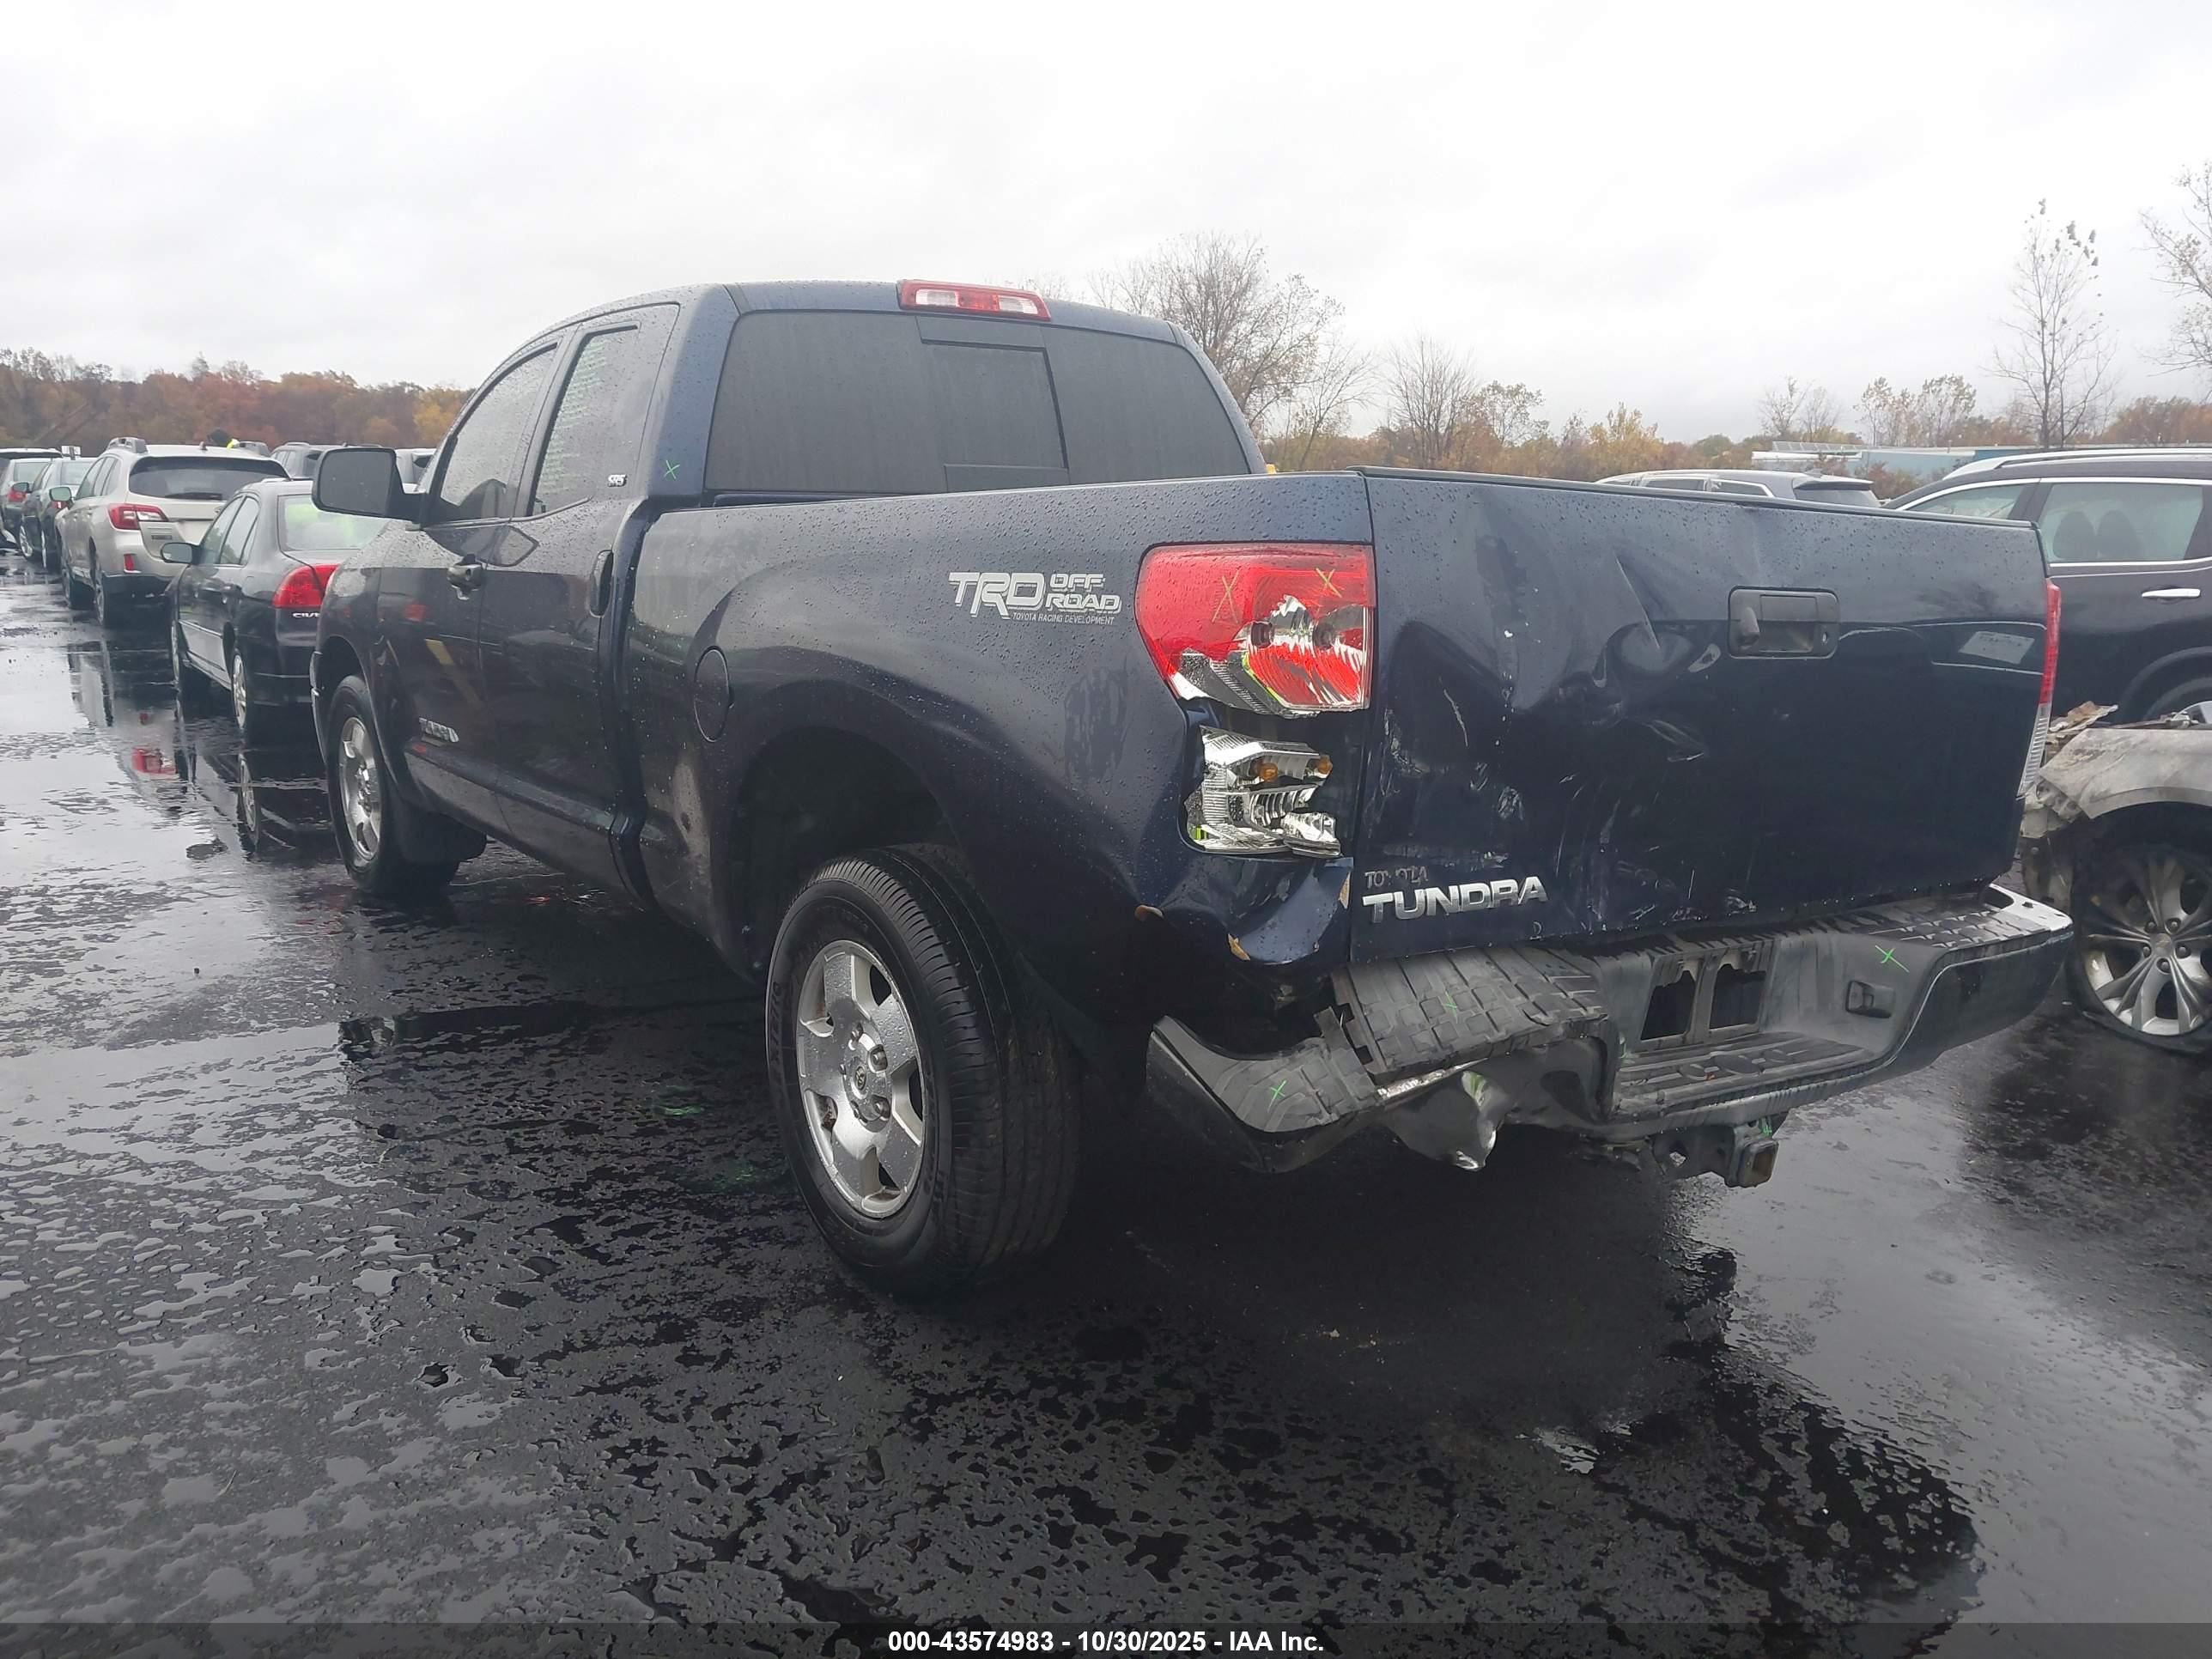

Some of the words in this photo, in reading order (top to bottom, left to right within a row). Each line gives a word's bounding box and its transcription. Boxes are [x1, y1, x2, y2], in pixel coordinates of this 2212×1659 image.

[1049, 573, 1105, 592] OFF
[948, 572, 1046, 619] TRD
[1045, 592, 1121, 614] ROAD
[1012, 611, 1036, 622] TOYOTA
[1037, 613, 1064, 623] RACING
[1064, 615, 1115, 625] DEVELOPMENT
[1362, 876, 1548, 923] TUNDRA
